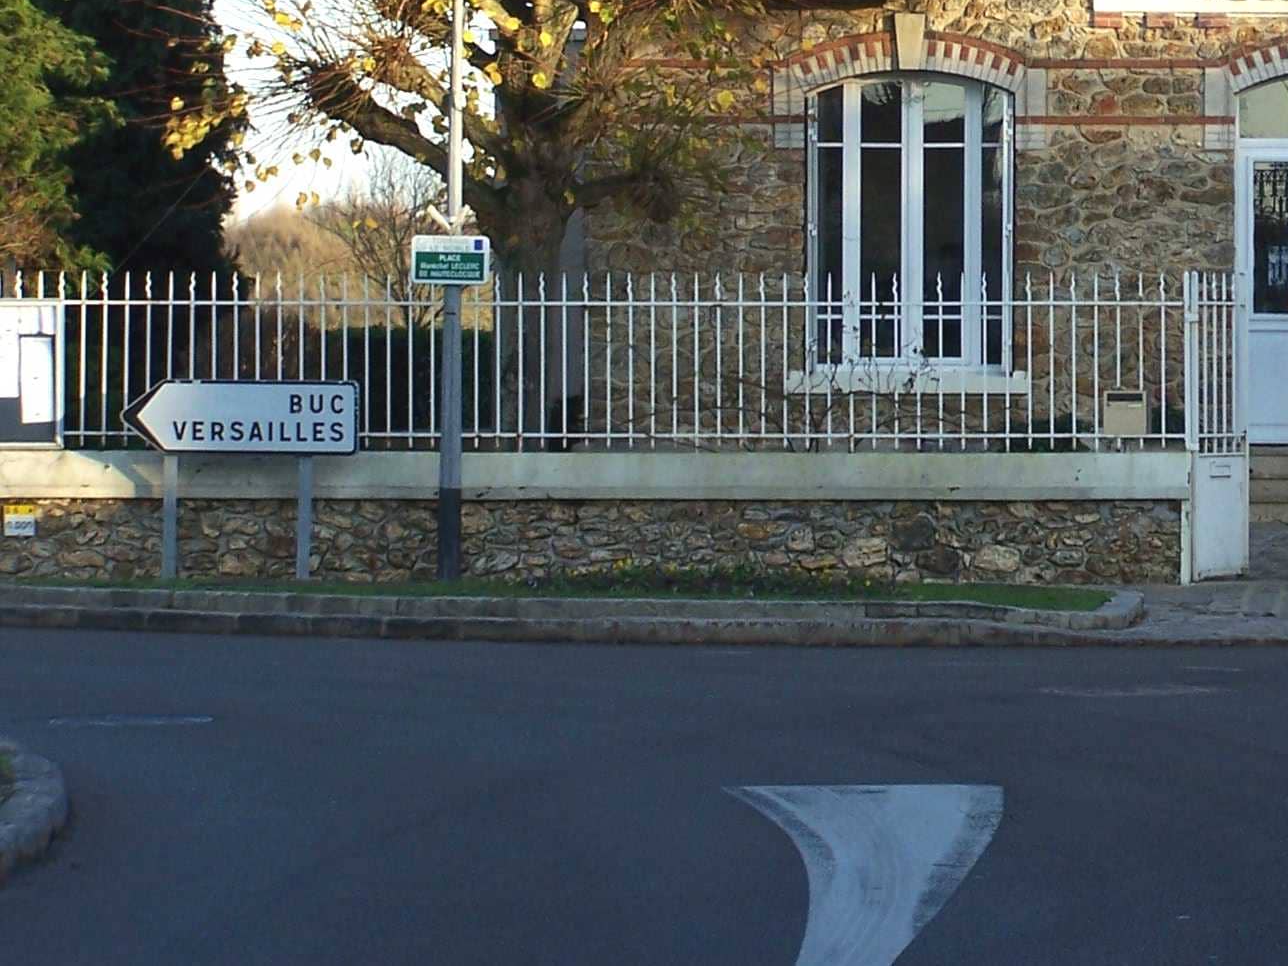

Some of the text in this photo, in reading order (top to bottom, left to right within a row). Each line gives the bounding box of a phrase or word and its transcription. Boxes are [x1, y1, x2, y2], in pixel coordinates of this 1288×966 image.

[439, 254, 461, 262] PLACE
[451, 262, 480, 270] LECLERC
[289, 394, 344, 414] BUC
[172, 421, 344, 442] VERSAILLES
